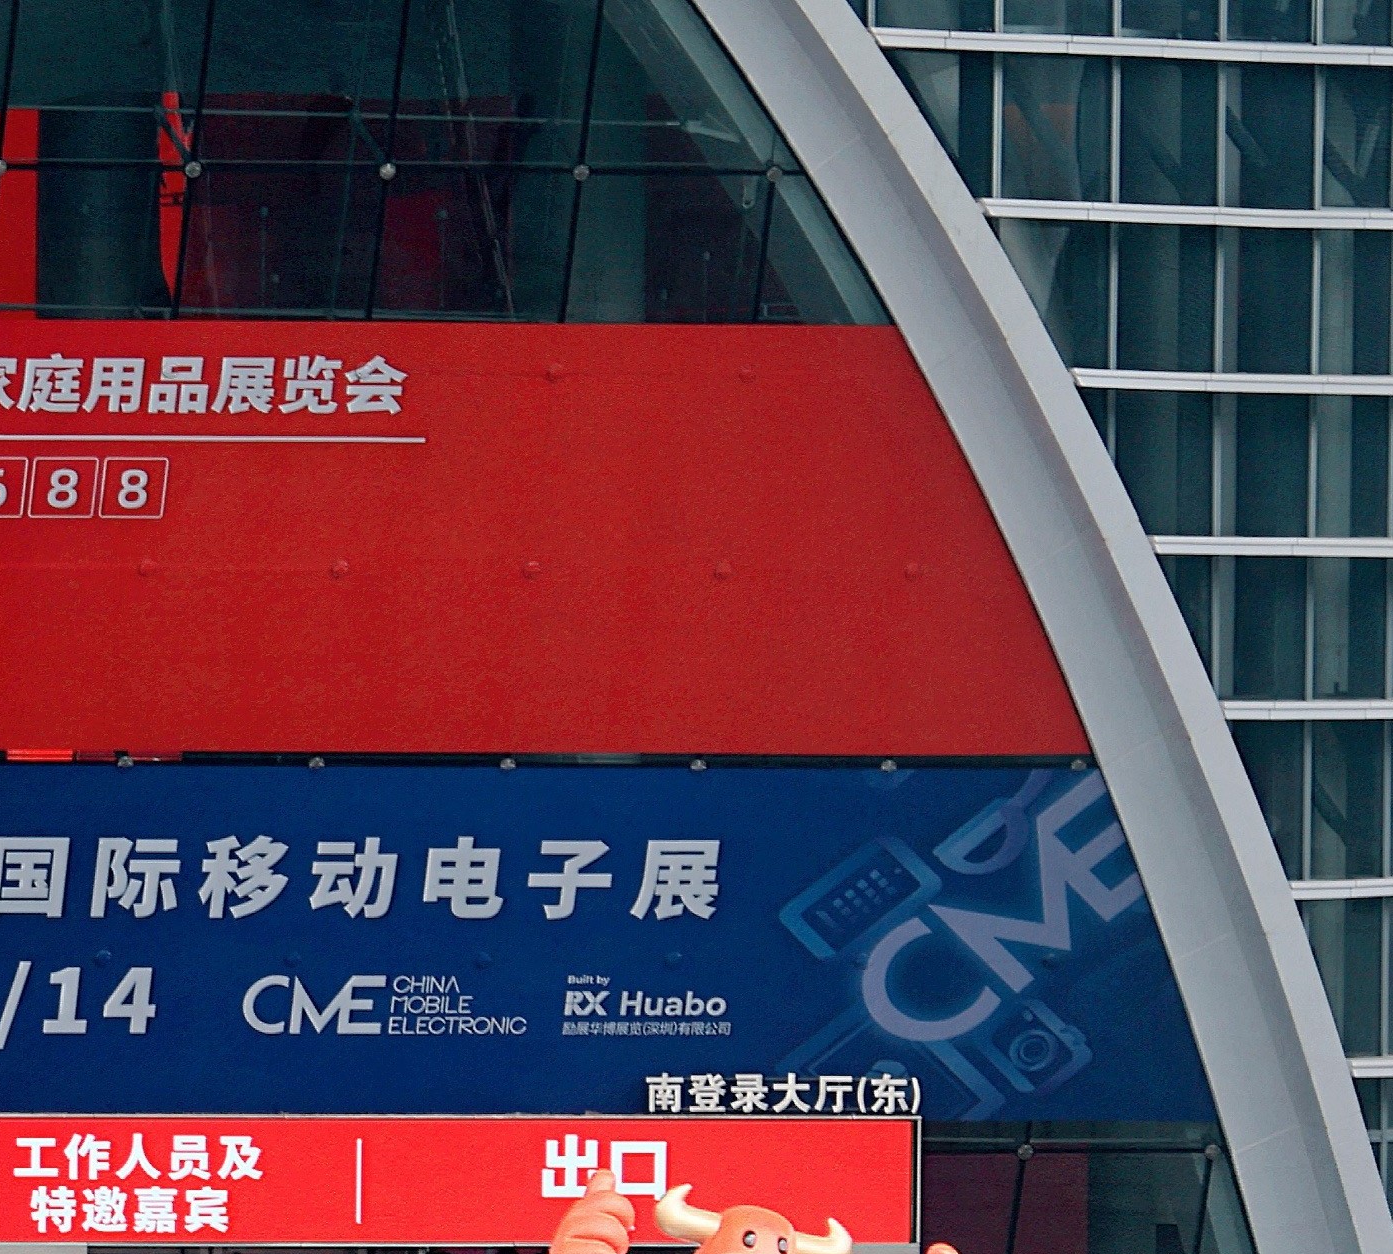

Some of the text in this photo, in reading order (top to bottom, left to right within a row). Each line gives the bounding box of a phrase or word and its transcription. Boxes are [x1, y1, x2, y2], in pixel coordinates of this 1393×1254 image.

[392, 975, 461, 995] CHINA
[567, 974, 611, 987] Built by
[242, 974, 388, 1035] CME
[390, 996, 474, 1014] MOBILE
[564, 991, 728, 1017] RX Huabo
[388, 1016, 527, 1035] ELECTRONIC
[645, 1072, 922, 1115] 南登录大厅(东)
[13, 1134, 264, 1183] 工作人员及
[540, 1133, 668, 1201] 出口
[30, 1185, 230, 1235] 特邀嘉宾
